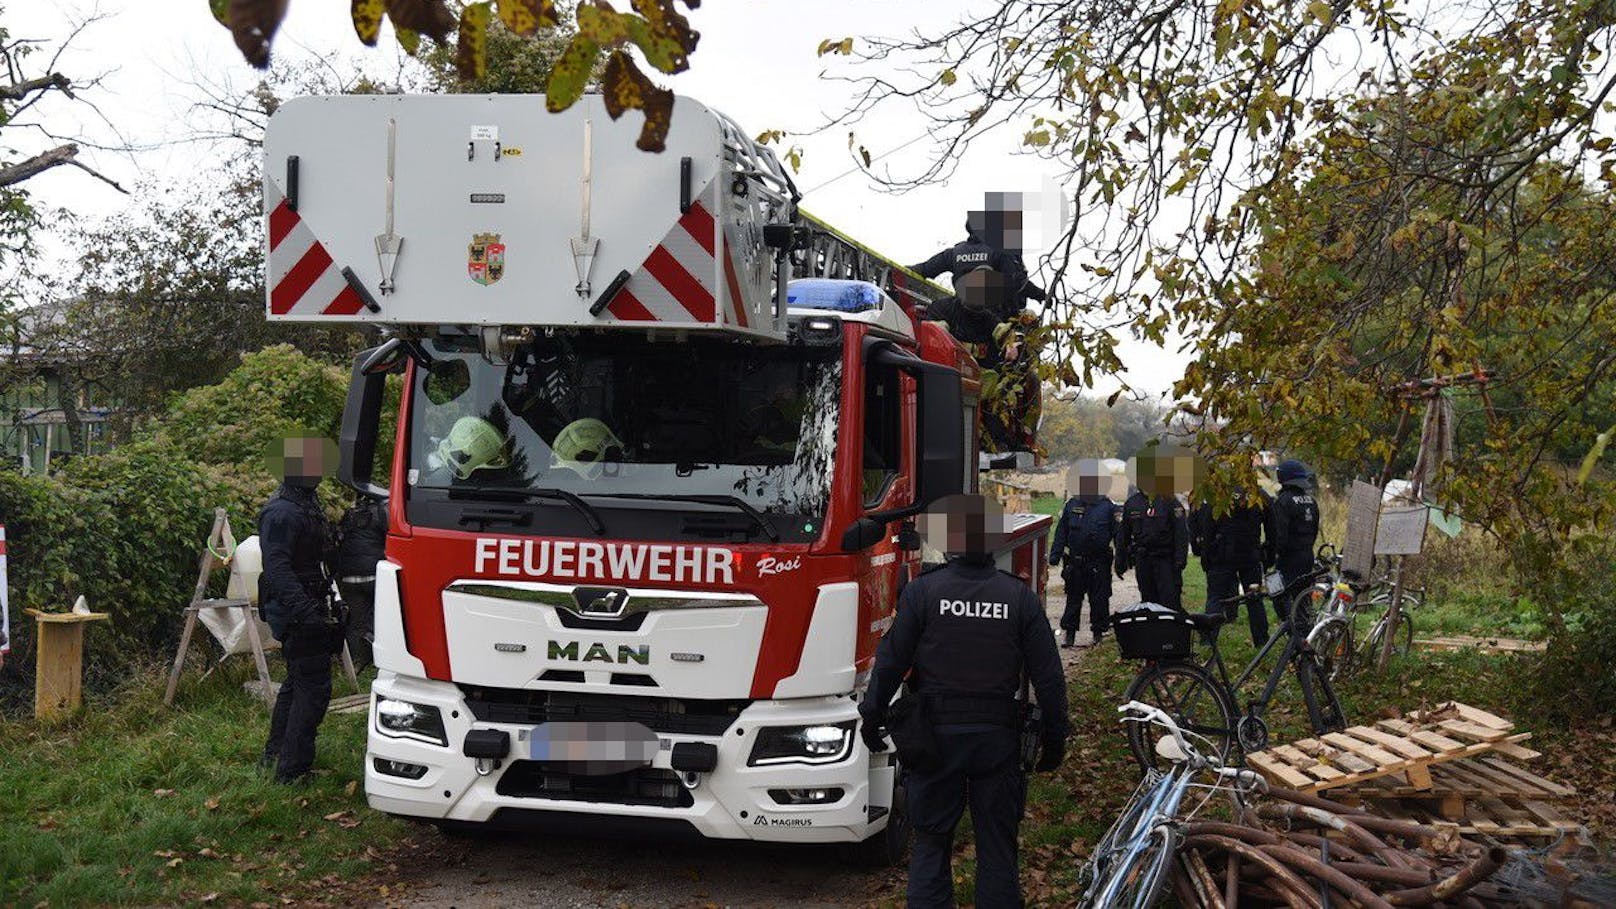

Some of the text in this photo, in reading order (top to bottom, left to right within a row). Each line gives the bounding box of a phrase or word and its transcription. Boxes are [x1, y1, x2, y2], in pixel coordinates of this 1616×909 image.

[956, 253, 988, 263] POLIZEI
[475, 537, 734, 584] FEUERWEHR
[756, 554, 801, 578] Rosi
[939, 599, 1009, 620] POLIZEI
[547, 640, 650, 666] MAN
[770, 819, 813, 827] MAGIRUS
